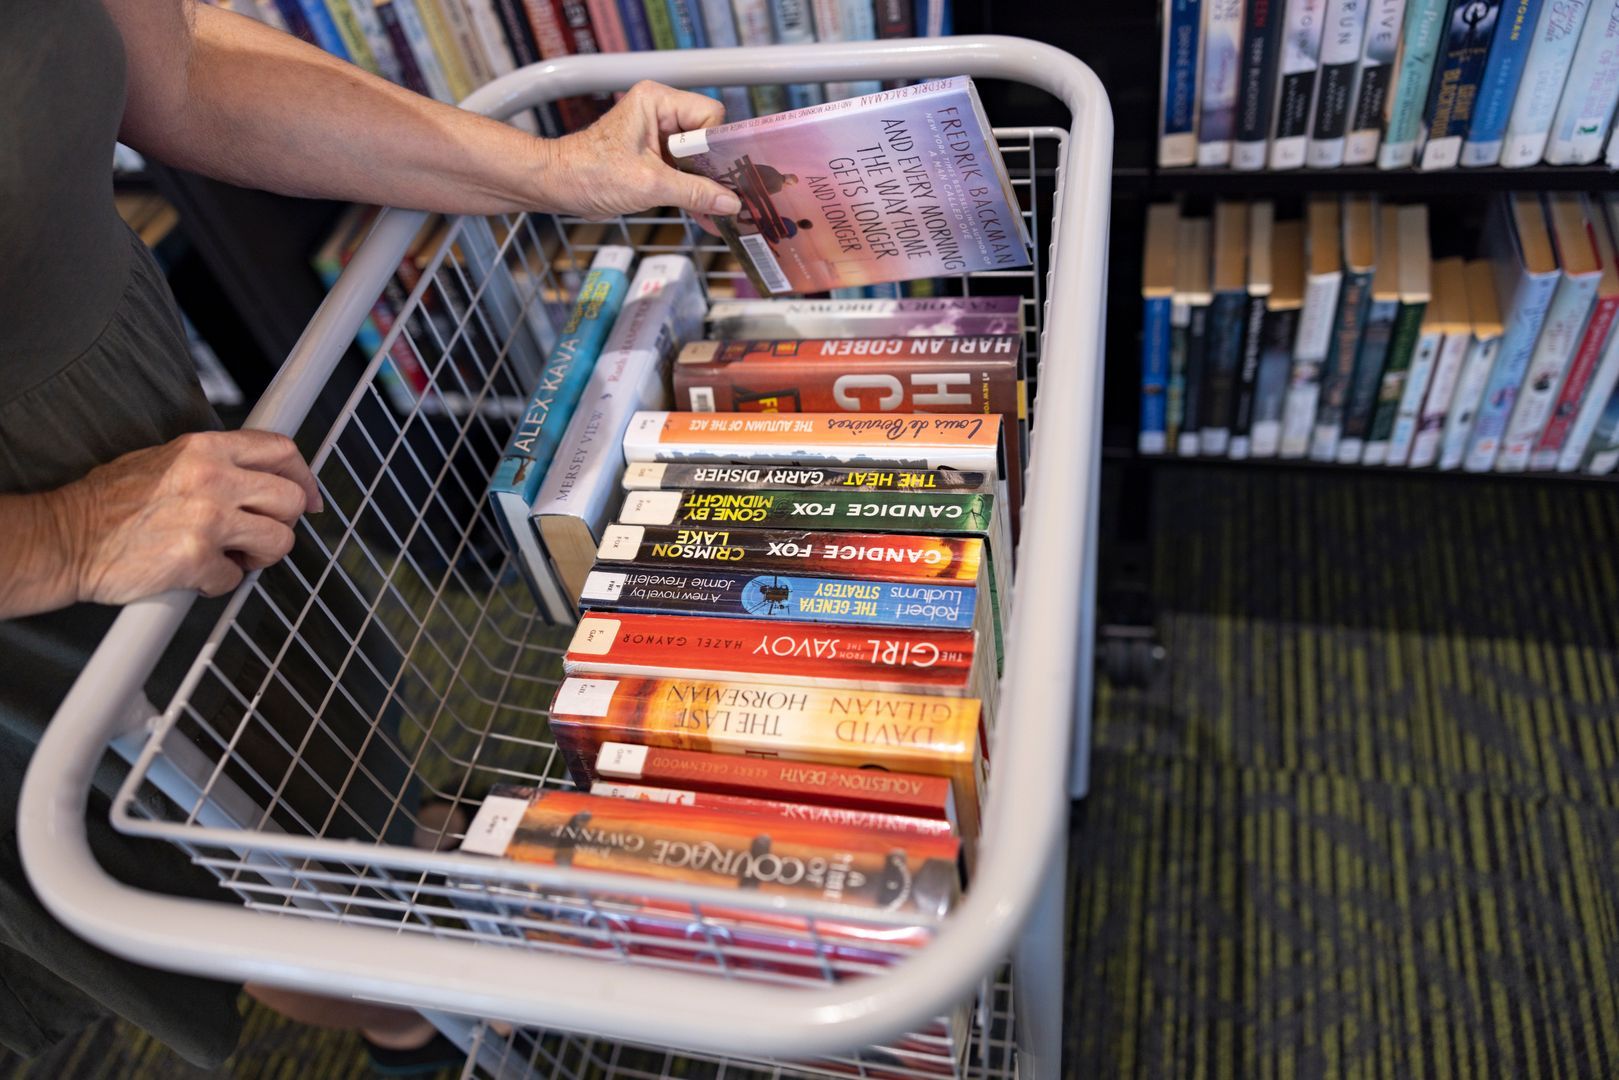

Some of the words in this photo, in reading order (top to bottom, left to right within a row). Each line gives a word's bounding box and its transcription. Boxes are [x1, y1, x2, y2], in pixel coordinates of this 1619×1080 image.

[912, 79, 954, 97] FREDRIK
[861, 89, 908, 107] BACKMAN
[881, 119, 914, 152] AND
[857, 142, 893, 178] THE
[897, 155, 937, 199] EVERY
[925, 112, 937, 132] NEW
[934, 133, 947, 155] YORK
[945, 157, 957, 180] TIMES
[952, 179, 975, 226] BESTSELLING
[972, 224, 987, 255] AUTHOR
[983, 255, 992, 265] OF
[937, 107, 983, 181] FREDRIK
[969, 186, 1015, 264] BACKMAN
[874, 178, 912, 216] WAY
[934, 161, 947, 180] MAN
[944, 184, 964, 221] CALLED
[959, 222, 973, 240] OVE
[805, 175, 835, 201] AND
[821, 203, 862, 253] LONGER
[829, 157, 868, 198] GETS
[850, 201, 899, 260] LONGER
[891, 219, 932, 260] HOME
[918, 205, 966, 270] MORNING
[895, 301, 998, 314] SANDRA
[821, 339, 902, 355] COBEN
[911, 336, 1013, 354] HARLAN
[514, 398, 553, 452] ALEX
[540, 338, 580, 391] KAVA
[690, 419, 708, 432] ACE
[710, 419, 729, 432] THE
[729, 419, 744, 432] OF
[750, 419, 796, 433] AUTUMN
[795, 419, 813, 432] THE
[827, 418, 911, 441] Bernières
[911, 420, 929, 440] de
[934, 419, 982, 440] Louis
[556, 448, 588, 501] MERSEY
[581, 411, 604, 444] VIEW
[694, 468, 760, 484] DISHER
[761, 469, 824, 485] GARRY
[843, 471, 894, 488] HEAT
[897, 472, 937, 488] THE
[636, 499, 644, 511] FOX
[684, 494, 774, 508] MIDNIGHT
[790, 502, 836, 516] FOX
[684, 507, 709, 521] BY
[712, 507, 768, 522] GONE
[848, 503, 962, 519] CANDICE
[614, 536, 622, 548] FOX
[676, 530, 730, 545] LAKE
[652, 544, 745, 561] CRIMSON
[767, 542, 812, 557] FOX
[823, 545, 942, 565] CANDICE
[606, 580, 615, 592] FRE
[624, 575, 687, 590] Freveletti
[691, 577, 735, 592] Jamie
[630, 587, 646, 600] by
[647, 590, 680, 603] novel
[681, 591, 709, 601] new
[711, 593, 721, 603] A
[814, 583, 880, 599] STRATEGY
[799, 598, 850, 615] GENEVA
[853, 602, 878, 616] THE
[896, 603, 960, 621] Robert
[587, 629, 596, 642] GAY
[622, 632, 687, 647] GAYNOR
[695, 637, 743, 650] HAZEL
[753, 634, 840, 659] SAVOY
[845, 643, 862, 651] THE
[867, 638, 939, 668] GIRL
[839, 651, 865, 660] FROM
[940, 650, 963, 663] THE
[666, 684, 809, 711] HORSEMAN
[829, 695, 952, 721] GILMAN
[674, 708, 732, 732] LAST
[737, 711, 782, 737] THE
[834, 719, 935, 747] DAVID
[652, 756, 728, 774] GREENWOOD
[732, 764, 768, 778] KERRY
[780, 768, 827, 783] DEATH
[838, 774, 911, 793] QUESTION
[911, 781, 923, 794] A
[549, 823, 645, 850] GWYNNE
[649, 838, 806, 885] COURAGE
